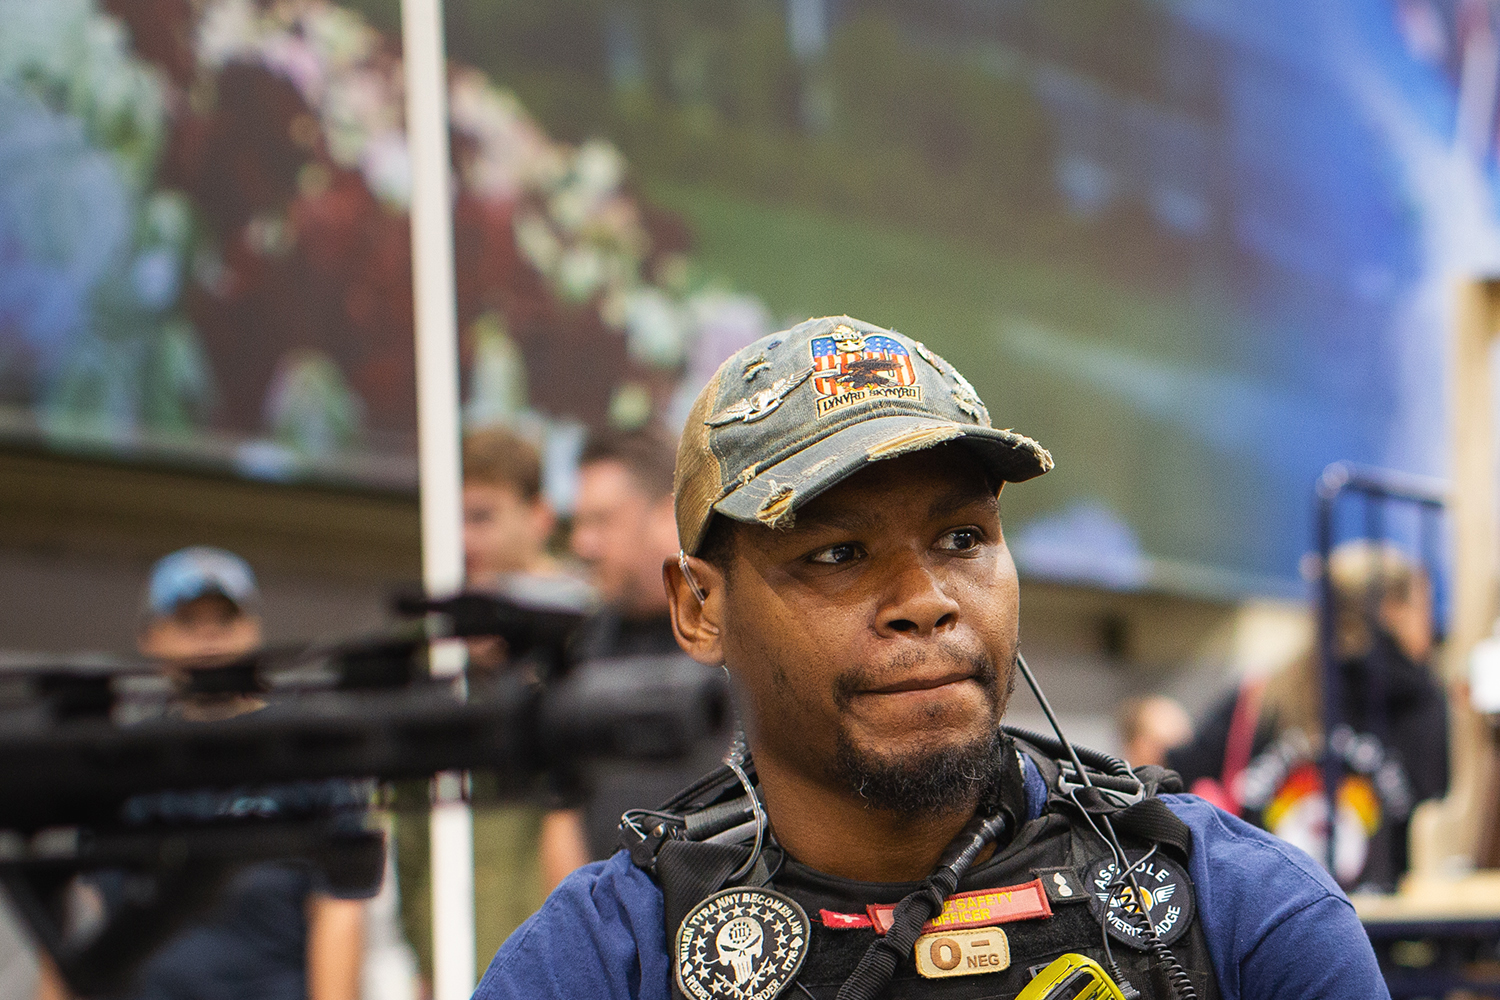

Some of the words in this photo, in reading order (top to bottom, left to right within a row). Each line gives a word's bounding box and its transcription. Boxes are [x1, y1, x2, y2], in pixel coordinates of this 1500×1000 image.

[823, 390, 865, 411] LYNYRD
[955, 891, 1013, 910] SAFETY
[680, 927, 695, 963] WHEN
[689, 893, 742, 927] TYRANNY
[741, 893, 793, 916] BECOMES
[786, 914, 803, 935] LAW
[1155, 904, 1181, 938] ADGE
[781, 950, 799, 971] 1776
[967, 954, 1000, 968] NEG
